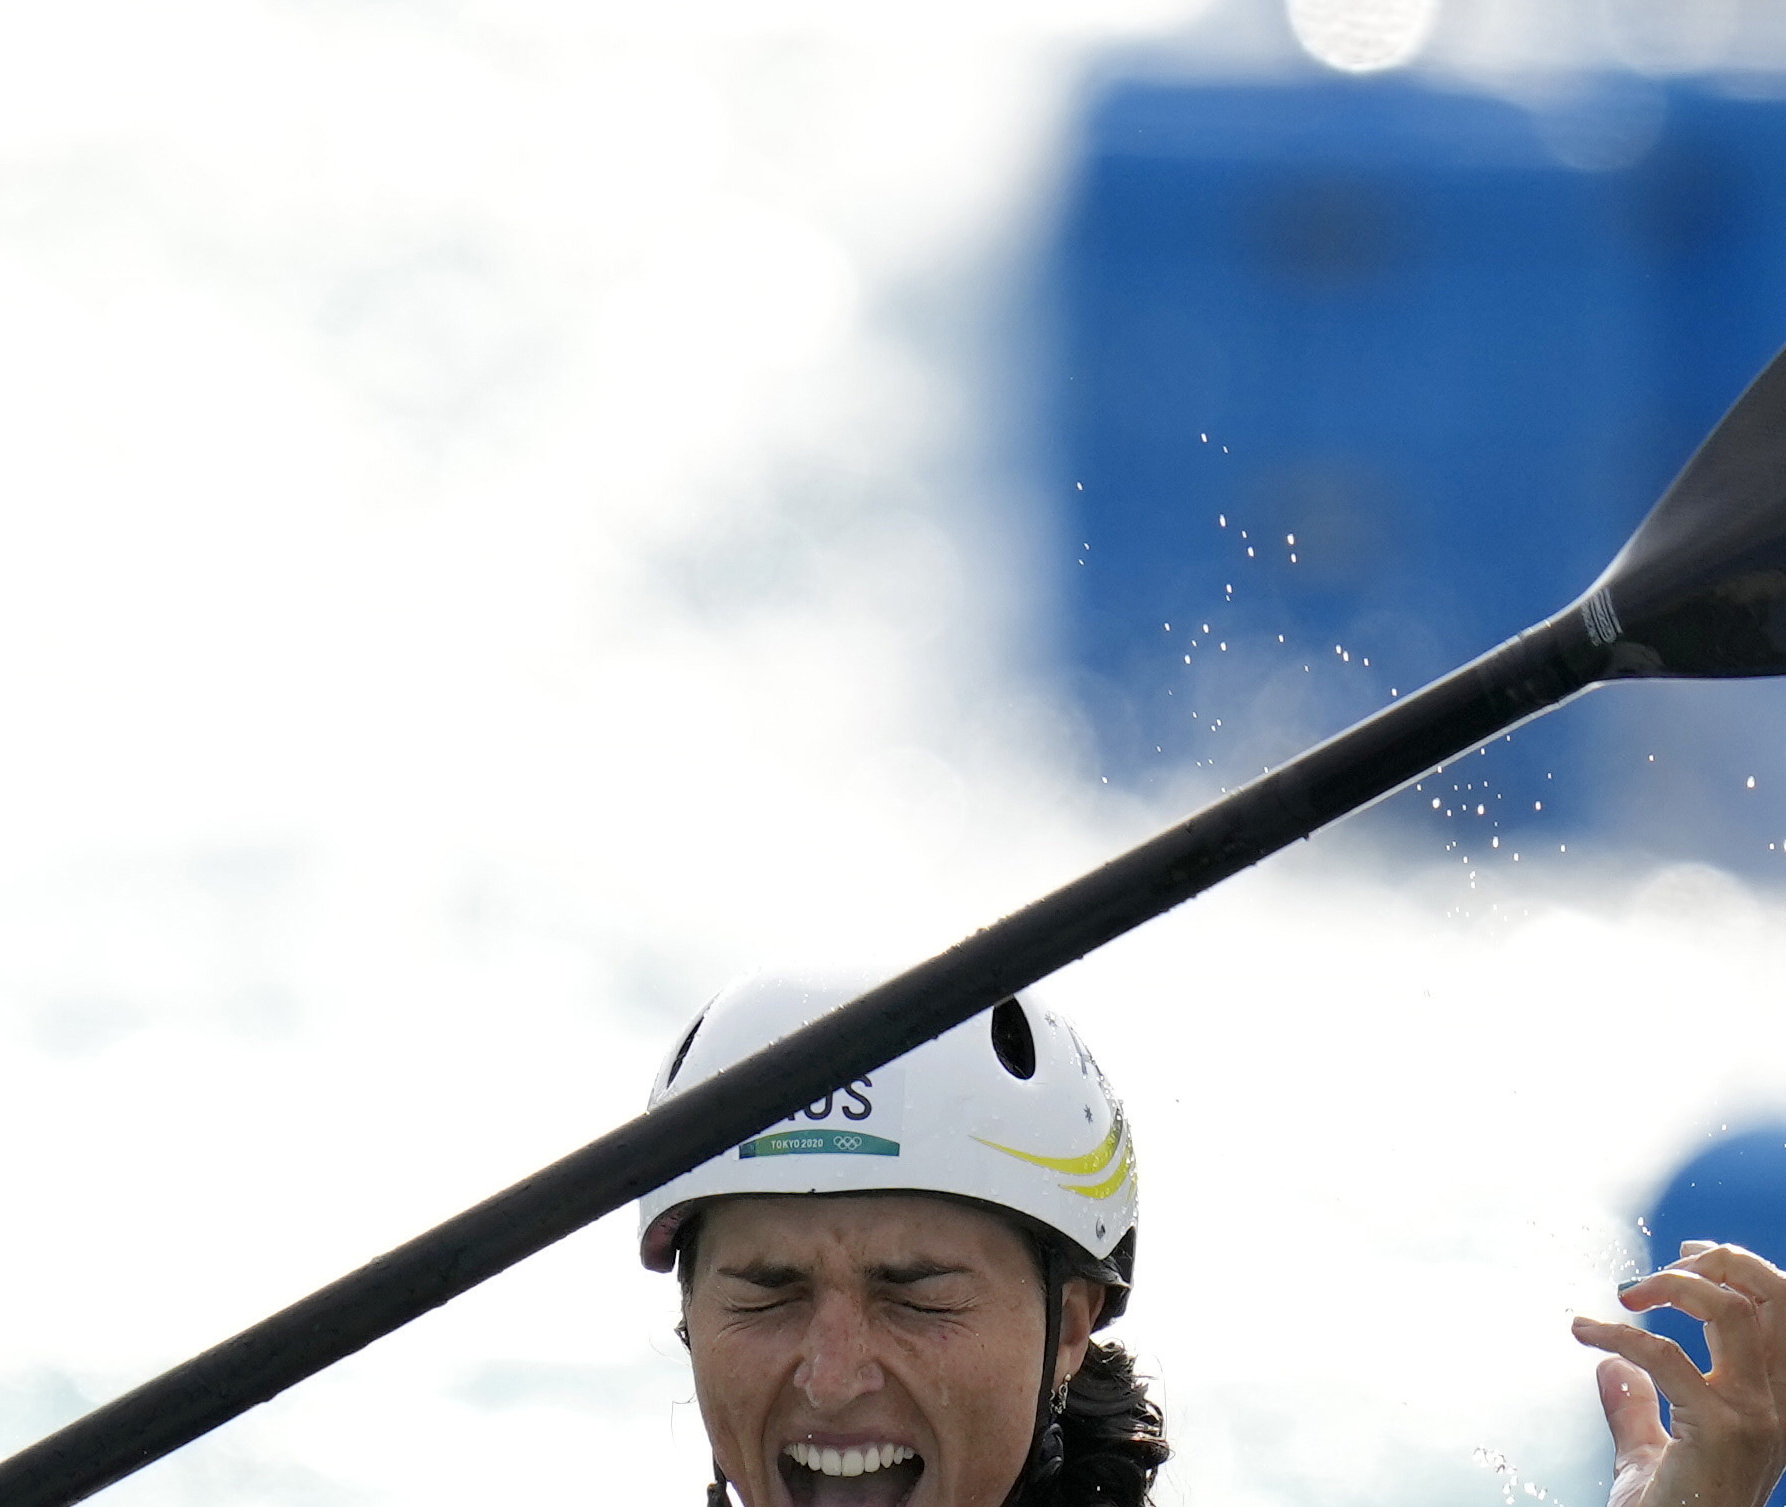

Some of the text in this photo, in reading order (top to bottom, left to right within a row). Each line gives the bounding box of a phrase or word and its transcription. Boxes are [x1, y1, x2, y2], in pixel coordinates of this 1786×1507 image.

[787, 1073, 873, 1121] US
[770, 1138, 824, 1150] TOKYO 2020
